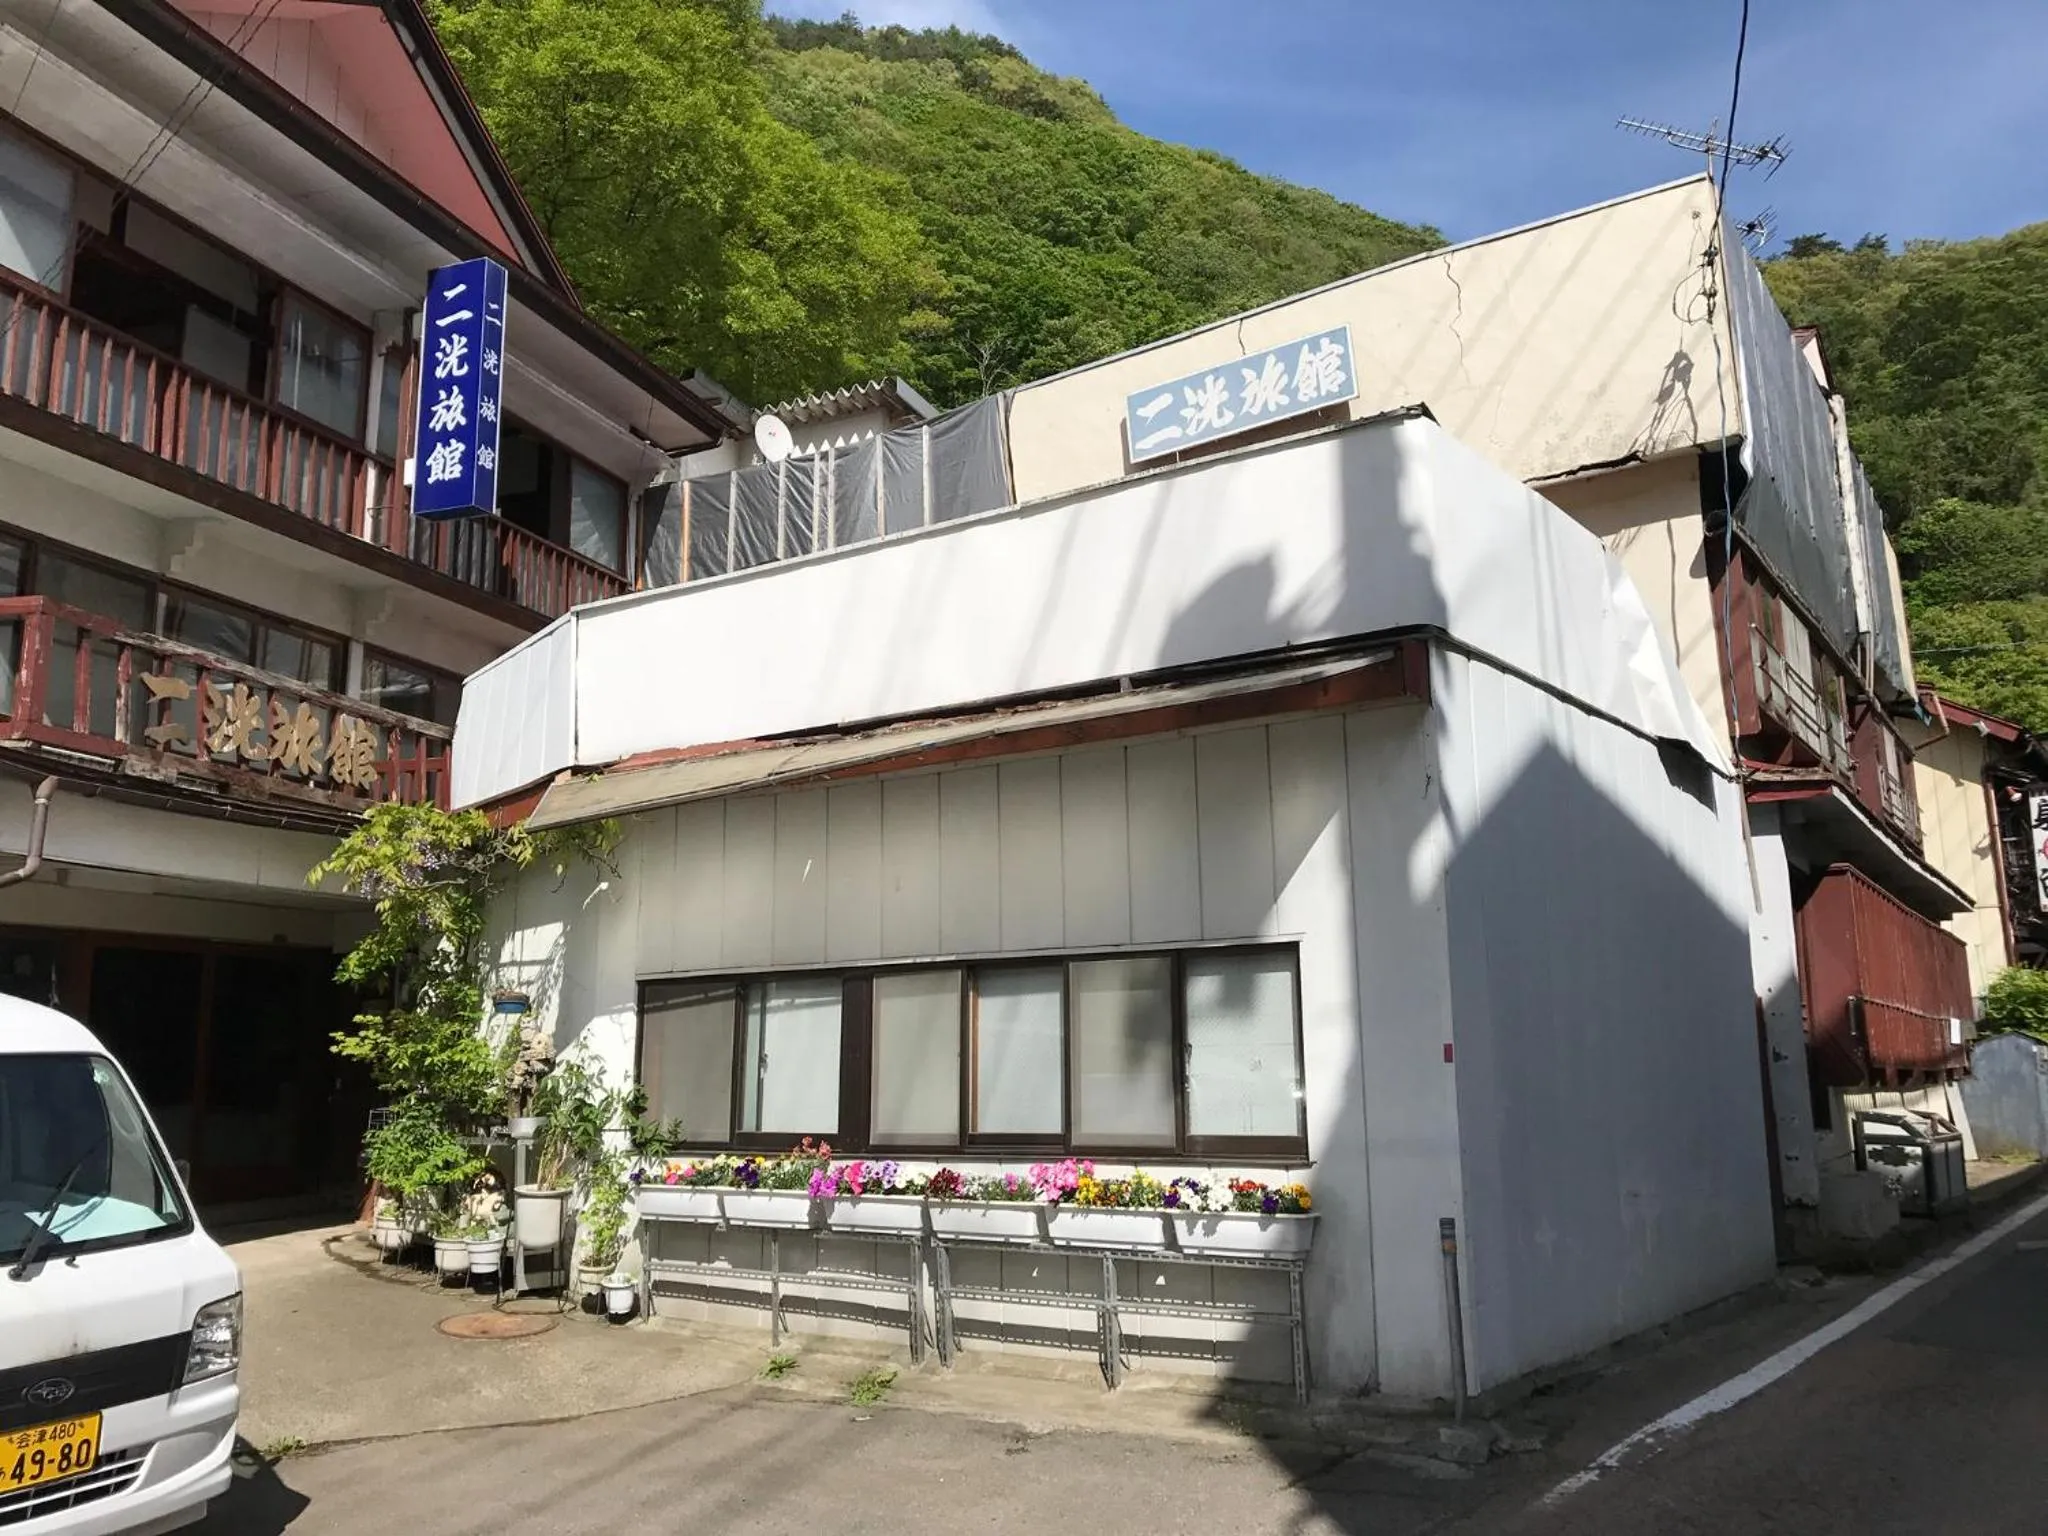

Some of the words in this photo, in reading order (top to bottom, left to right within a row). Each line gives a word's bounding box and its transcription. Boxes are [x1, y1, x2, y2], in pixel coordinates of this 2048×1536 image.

[426, 283, 474, 484] 二洸旅館
[1135, 337, 1347, 450] 二洸旅館
[10, 1438, 91, 1484] 49-80
